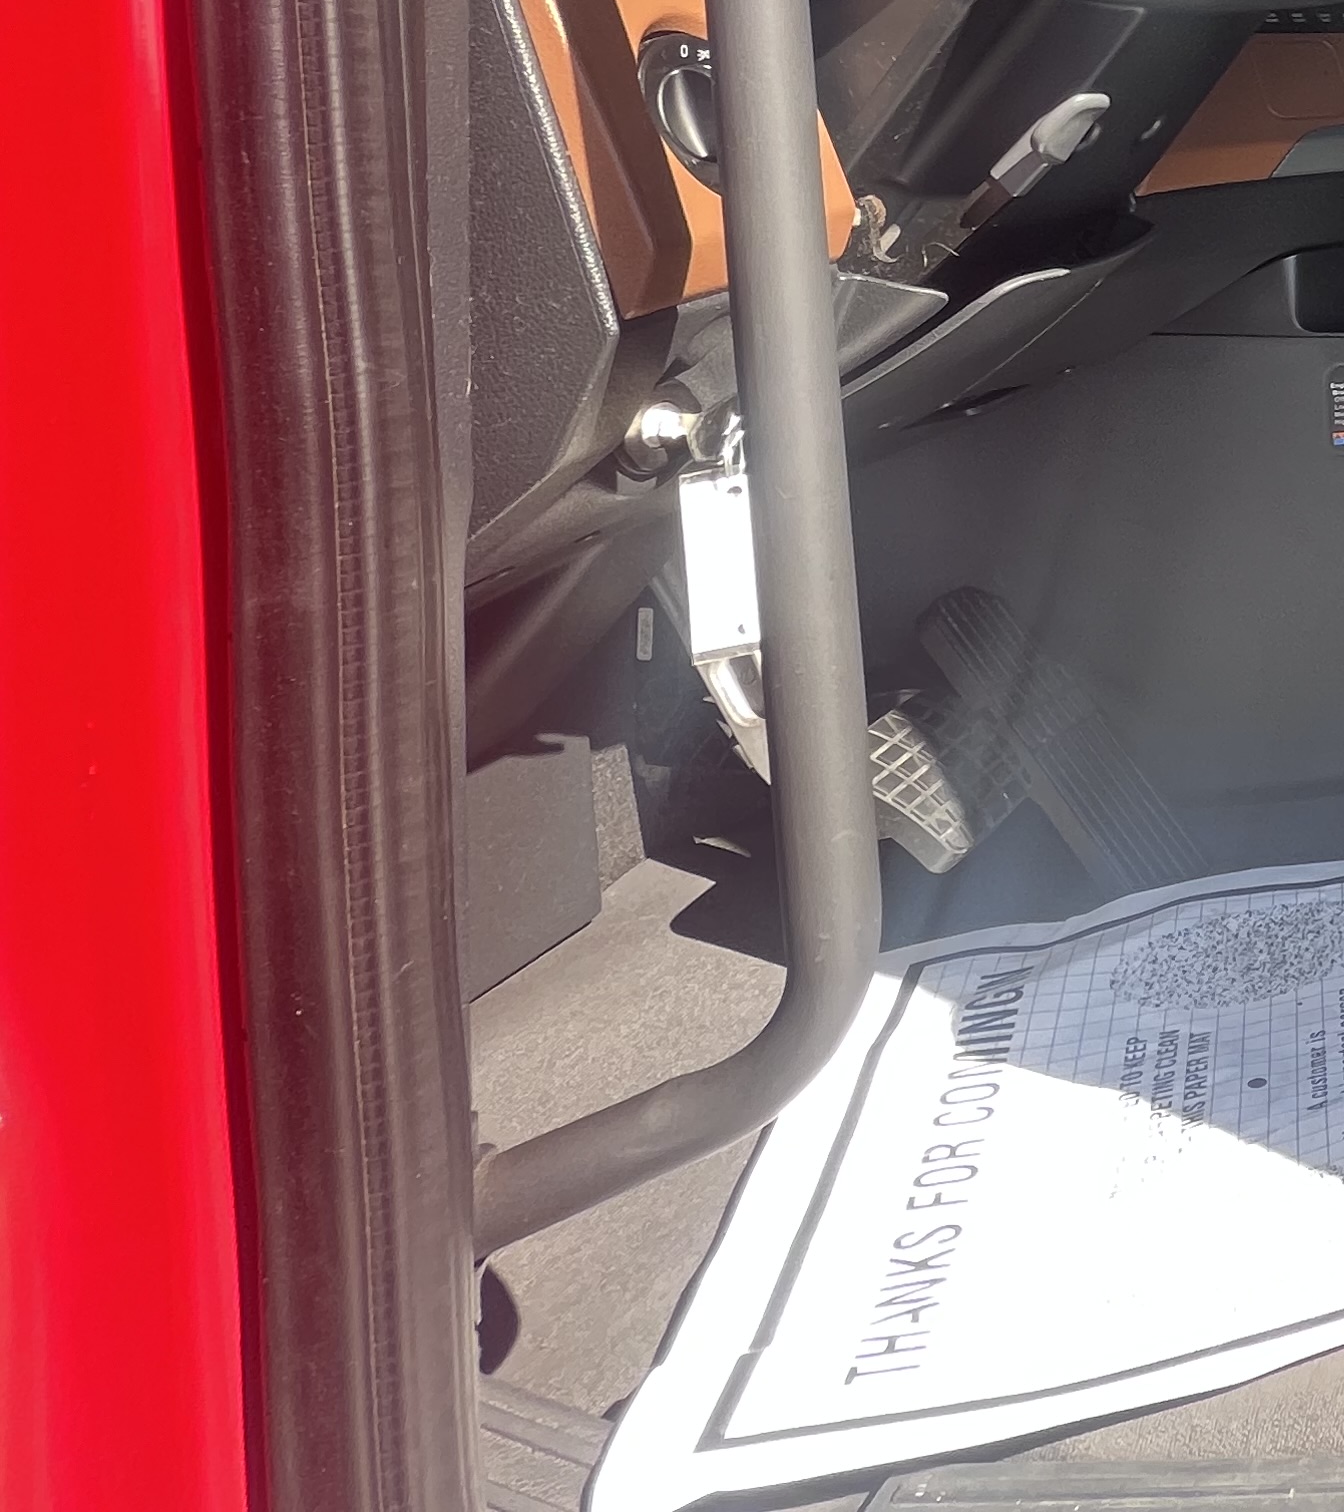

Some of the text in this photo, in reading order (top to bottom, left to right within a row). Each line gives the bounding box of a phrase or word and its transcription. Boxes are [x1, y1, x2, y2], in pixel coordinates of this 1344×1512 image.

[1123, 1036, 1148, 1070] KEEP
[1155, 1029, 1180, 1070] CLEAN
[1188, 1031, 1212, 1055] MAT
[1119, 1071, 1143, 1090] TO
[1183, 1055, 1209, 1100] PAPER
[1305, 1029, 1328, 1110] A customer is
[844, 1223, 963, 1385] THANKS
[906, 1137, 985, 1210] FOR
